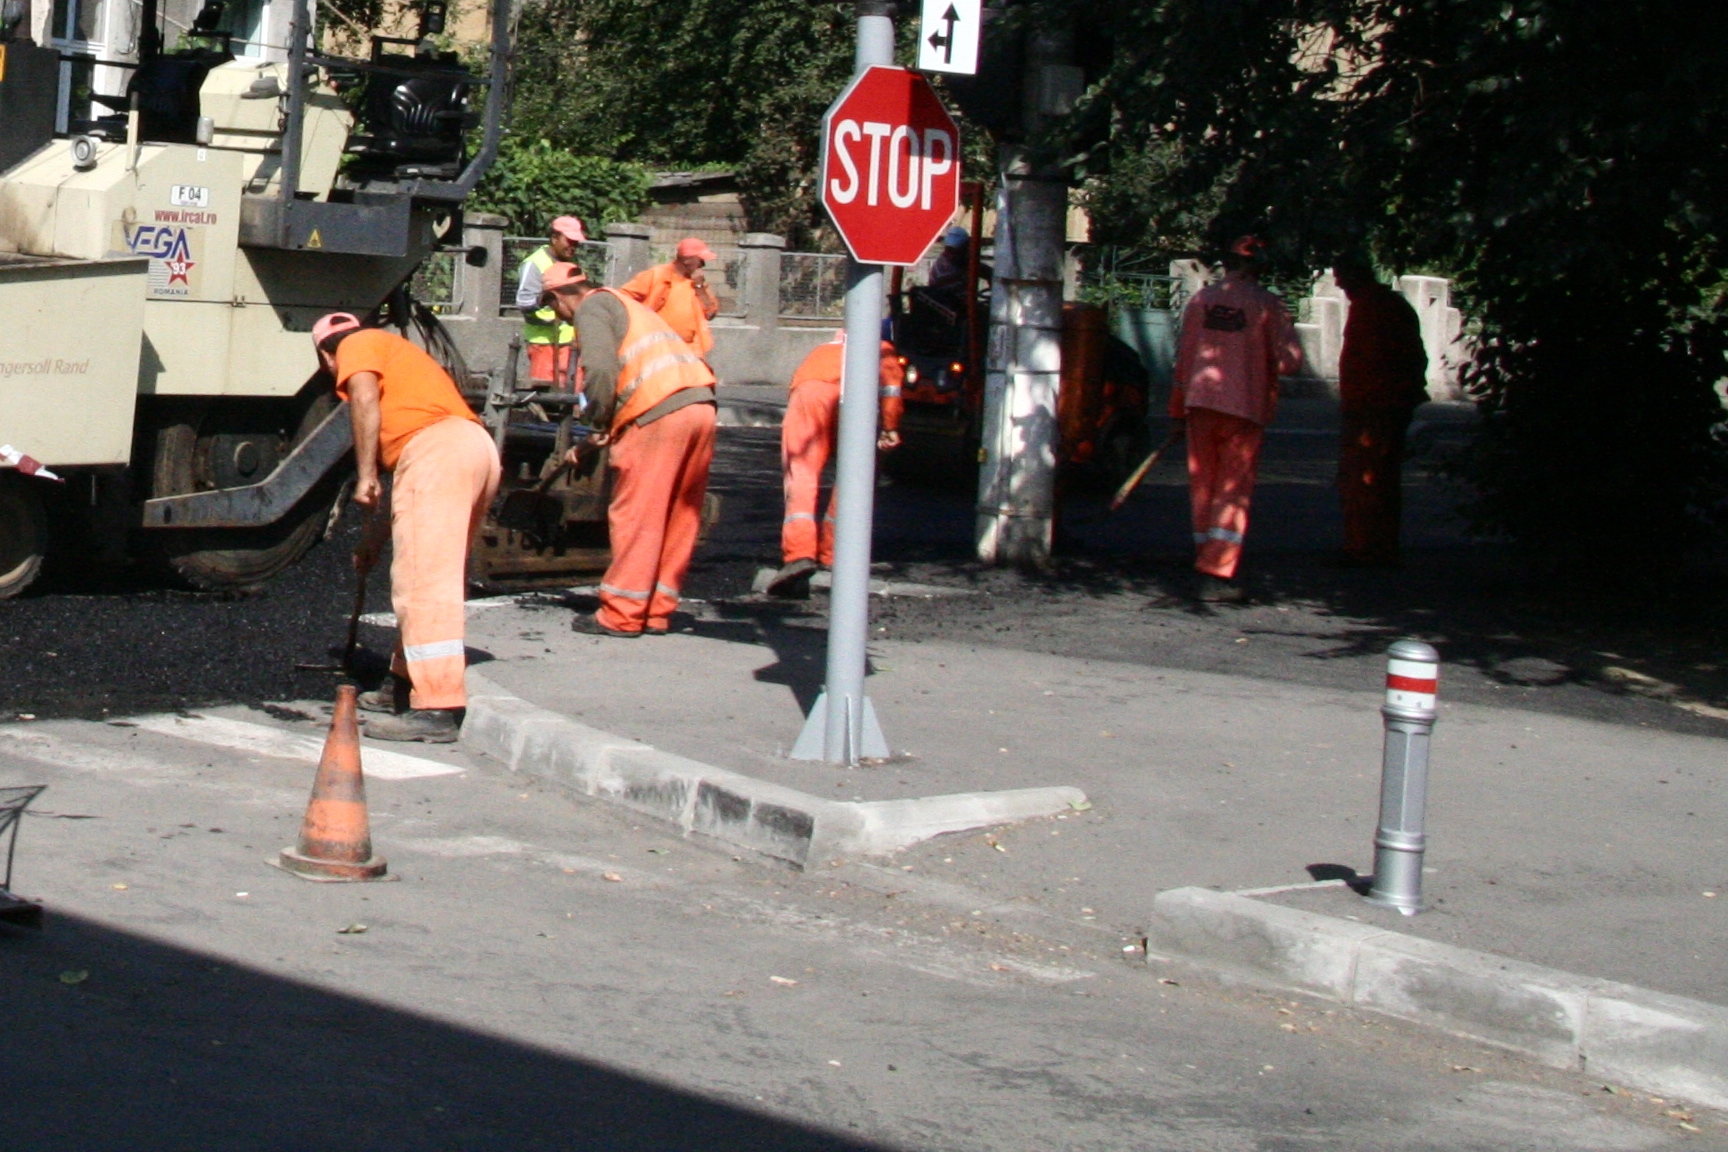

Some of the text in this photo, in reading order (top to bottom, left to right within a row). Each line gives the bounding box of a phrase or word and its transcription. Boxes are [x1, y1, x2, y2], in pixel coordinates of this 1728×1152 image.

[830, 118, 953, 211] STOP
[178, 186, 202, 201] F 04
[54, 358, 90, 375] Rand
